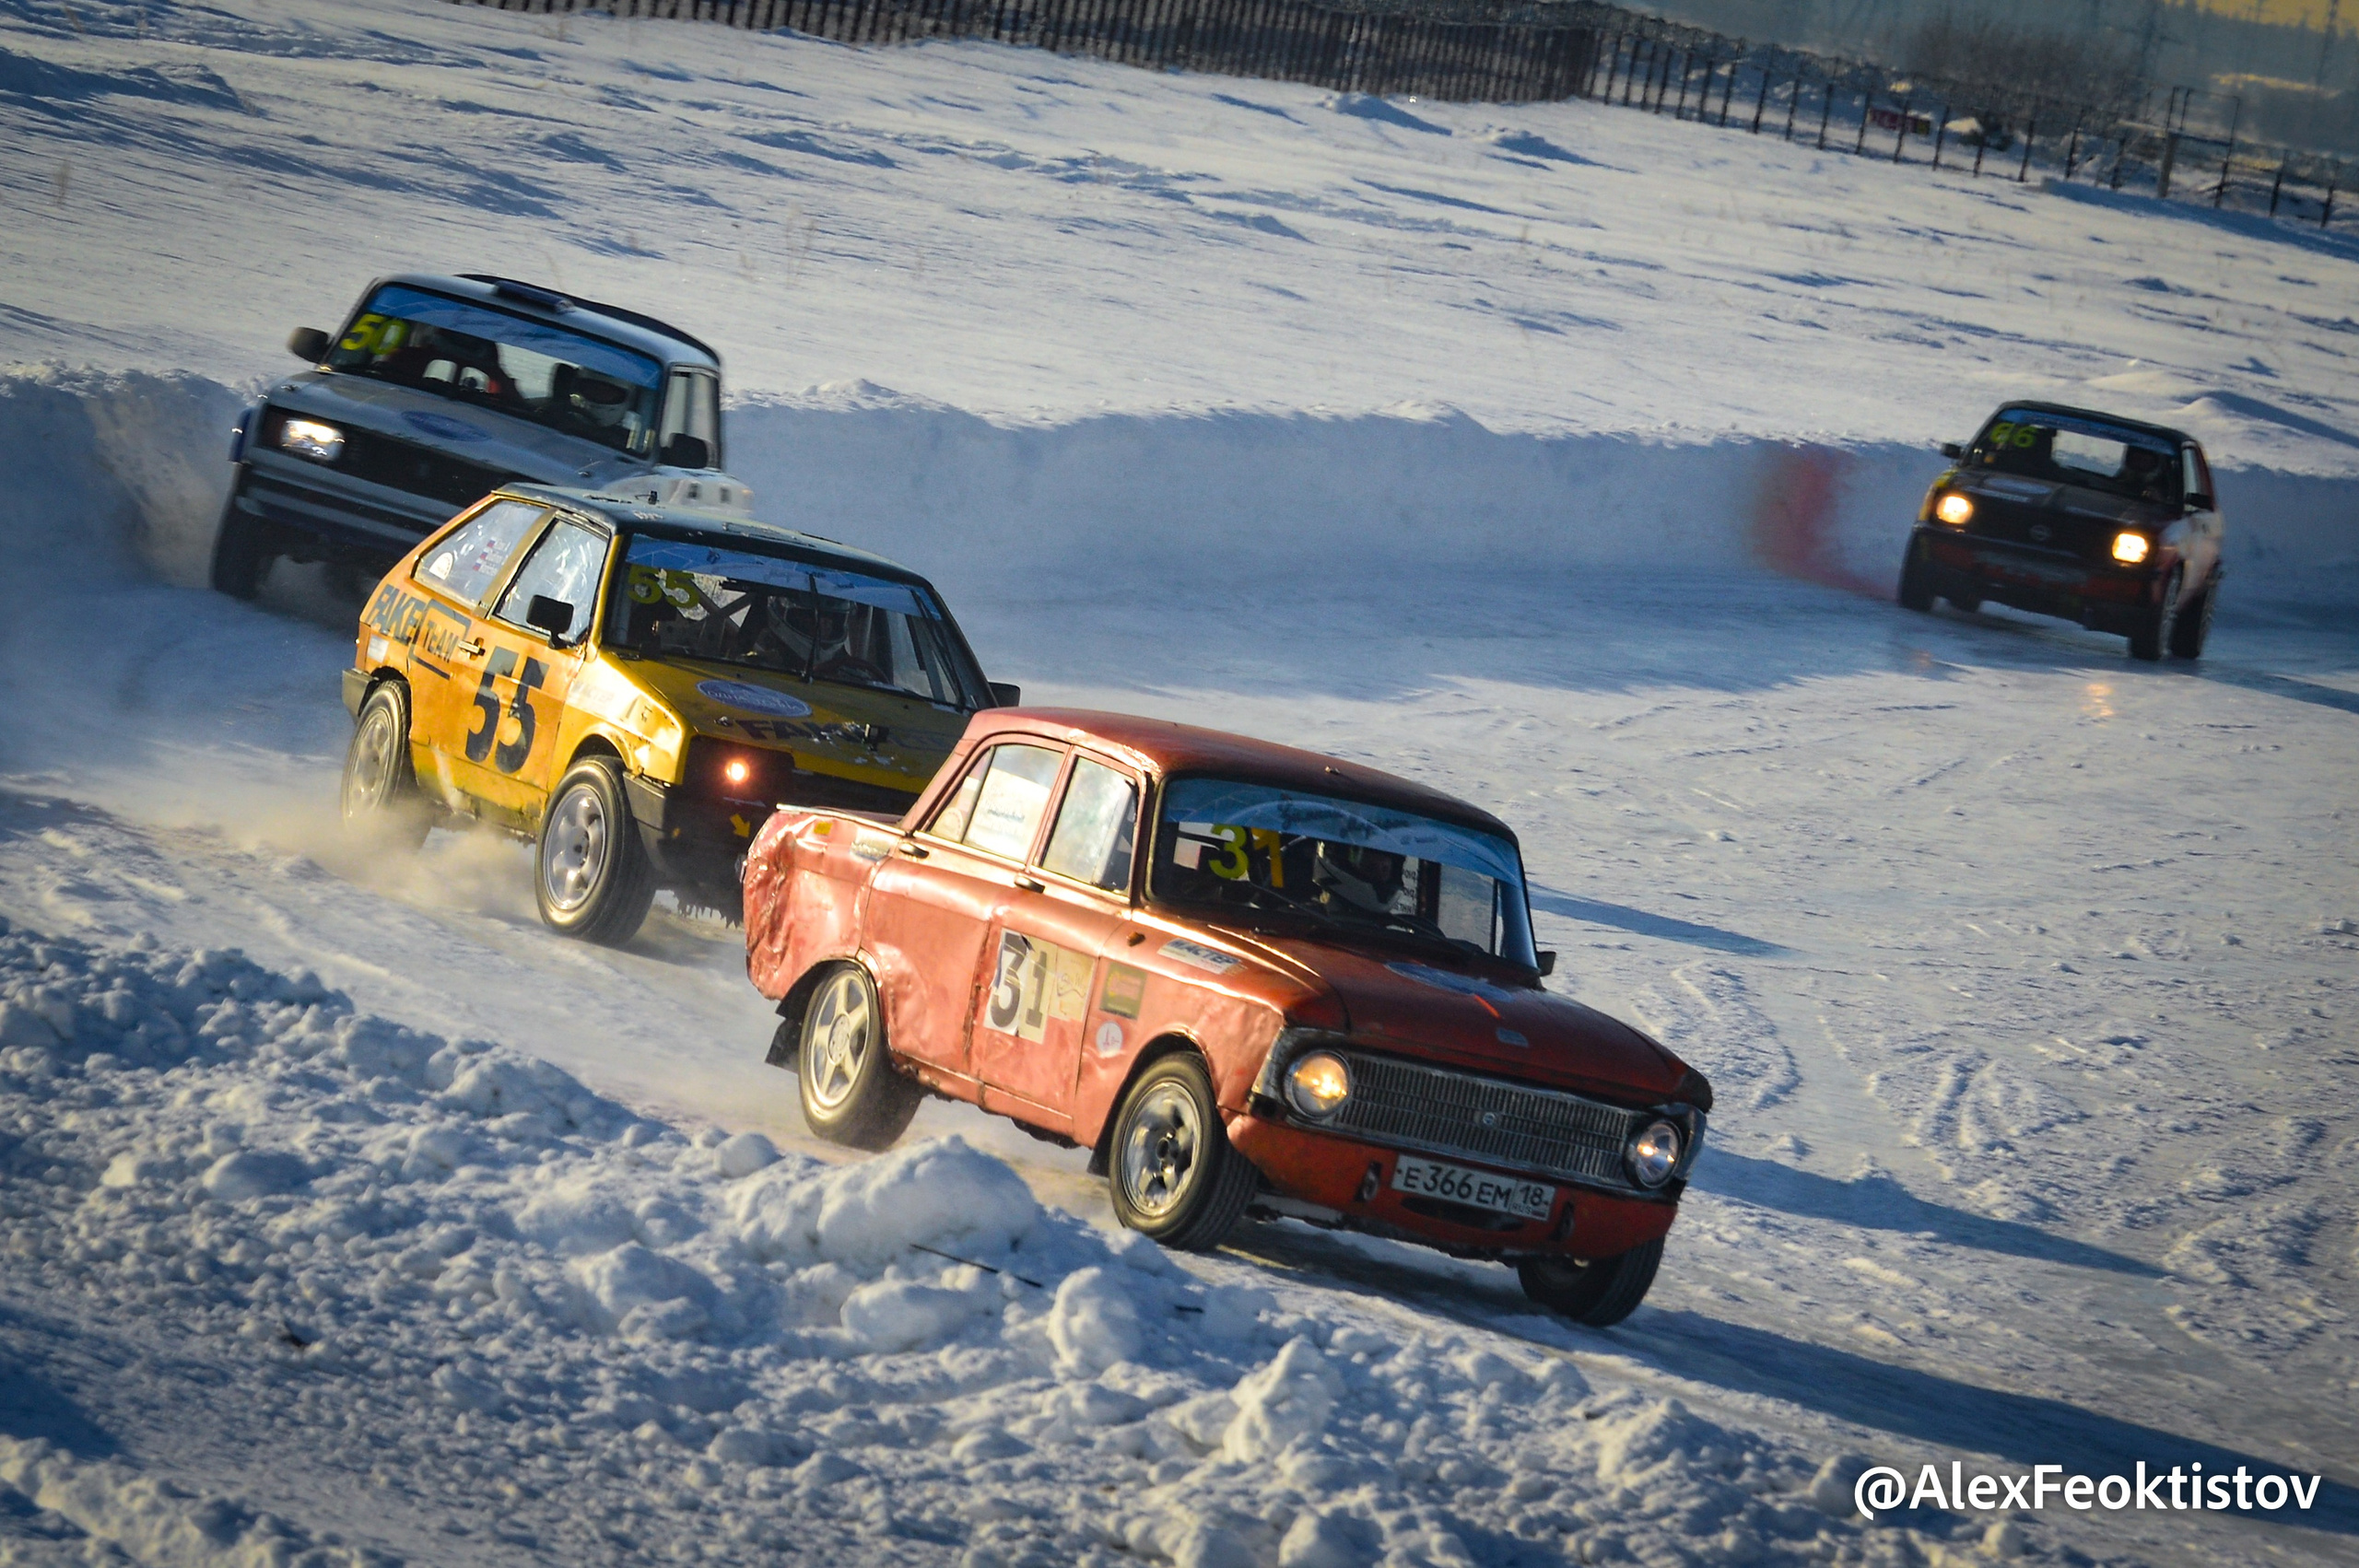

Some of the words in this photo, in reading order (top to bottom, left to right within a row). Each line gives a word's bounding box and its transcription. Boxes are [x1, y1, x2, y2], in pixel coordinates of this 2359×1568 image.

[340, 314, 409, 356] 50
[628, 565, 698, 609] 55
[365, 583, 427, 646] FAKE
[424, 619, 459, 663] TEAM
[465, 646, 550, 774] 55
[1209, 824, 1284, 888] 31
[990, 931, 1048, 1029] 31
[1520, 1185, 1544, 1207] 18
